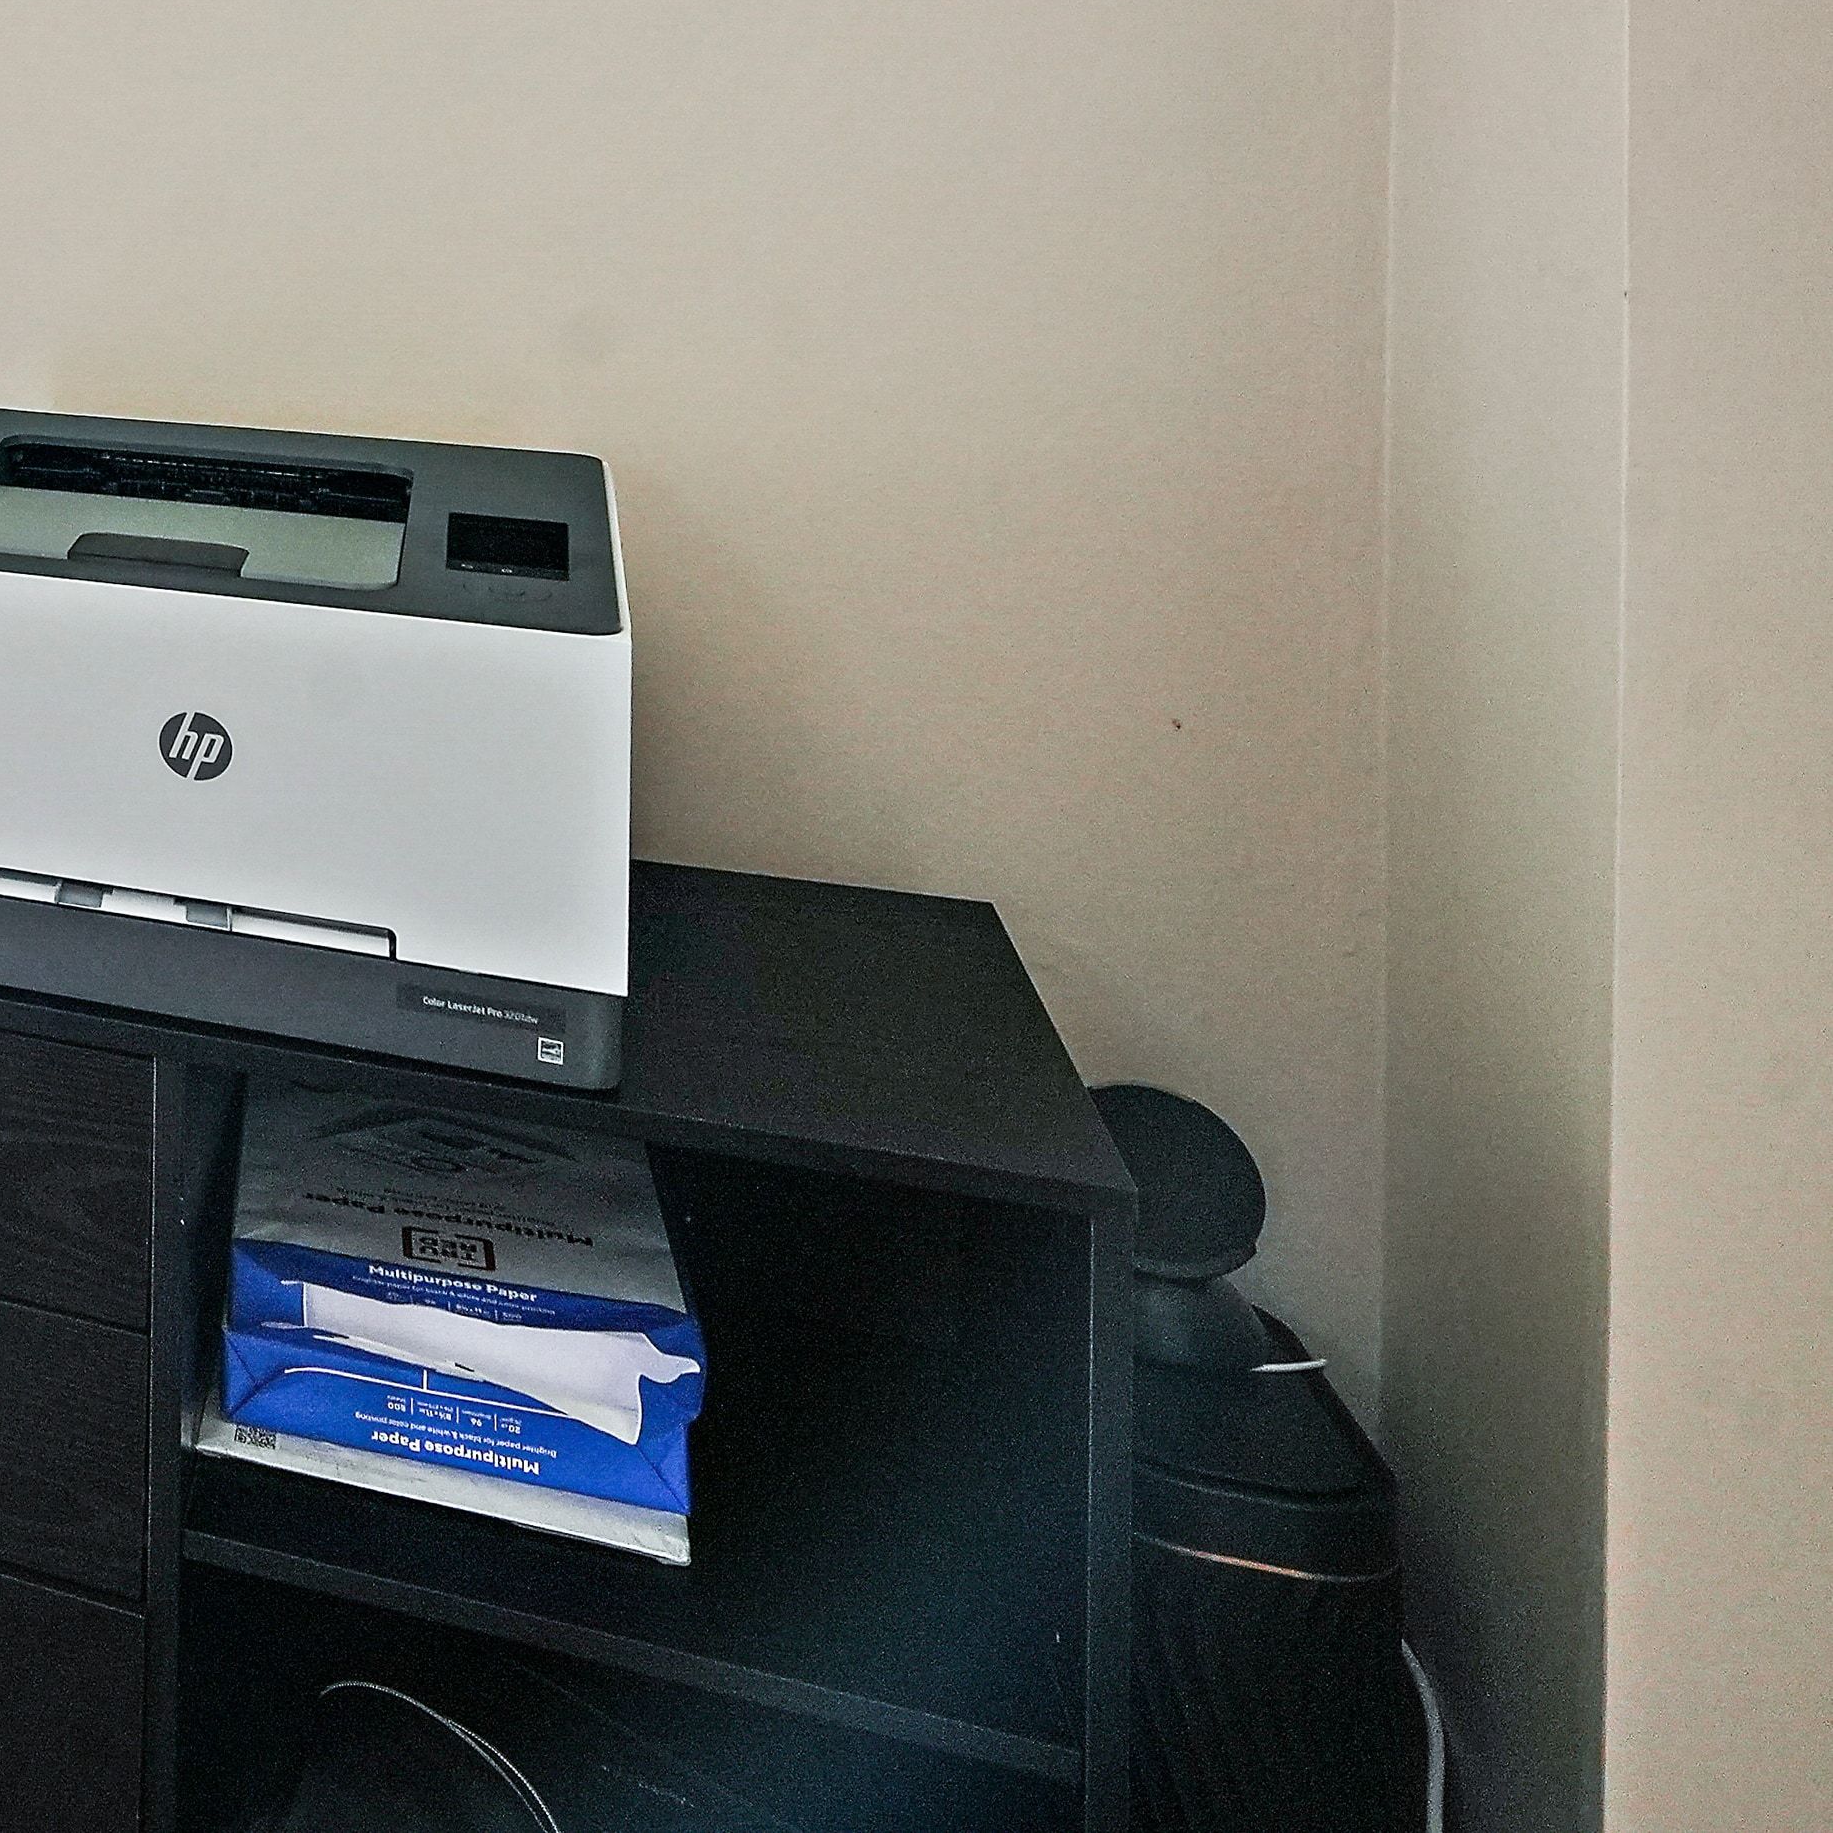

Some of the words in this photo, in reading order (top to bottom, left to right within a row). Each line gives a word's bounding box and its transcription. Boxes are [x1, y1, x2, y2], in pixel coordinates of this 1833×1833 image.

[167, 711, 225, 781] hp
[422, 995, 446, 1008] Color
[447, 1000, 485, 1016] LaserJet
[486, 1007, 502, 1019] Pro
[304, 1193, 385, 1213] Paper
[394, 1208, 594, 1247] Multipurpose
[369, 1264, 482, 1291] Multipurpose
[486, 1284, 538, 1302] Paper
[410, 1422, 427, 1433] and
[427, 1426, 451, 1438] white
[470, 1416, 483, 1428] 96
[370, 1430, 421, 1453] Paper
[459, 1432, 482, 1444] black
[494, 1439, 521, 1451] paper
[424, 1439, 540, 1476] Multipurpose
